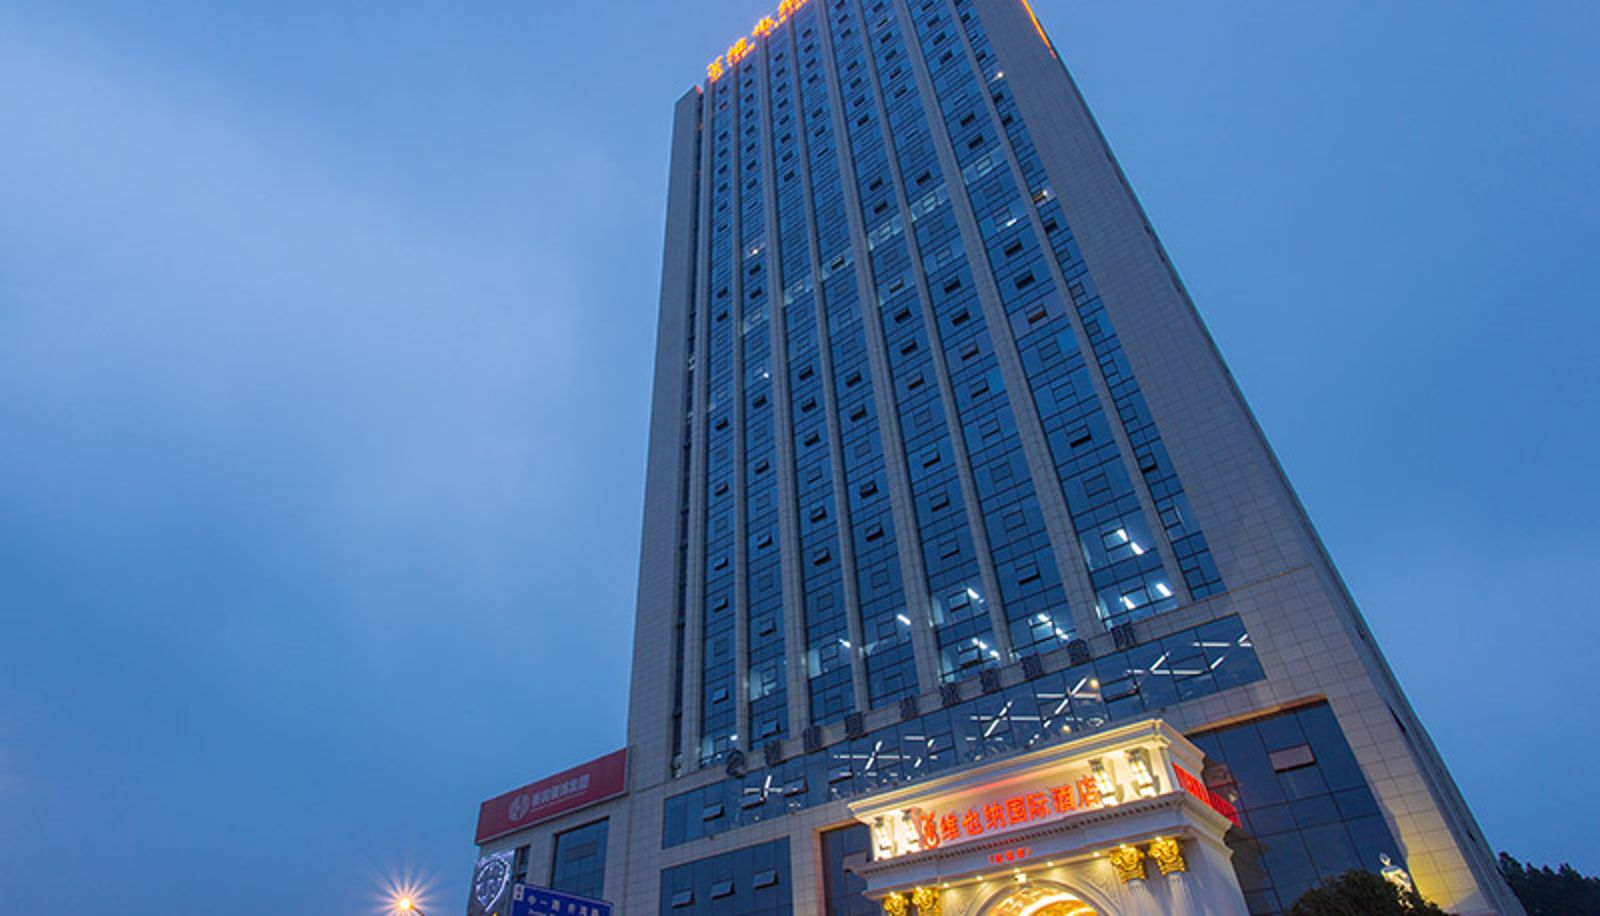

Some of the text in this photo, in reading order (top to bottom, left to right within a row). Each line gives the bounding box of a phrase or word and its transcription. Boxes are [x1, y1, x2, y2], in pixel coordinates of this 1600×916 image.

[940, 775, 1101, 842] 维也纳国际酒店
